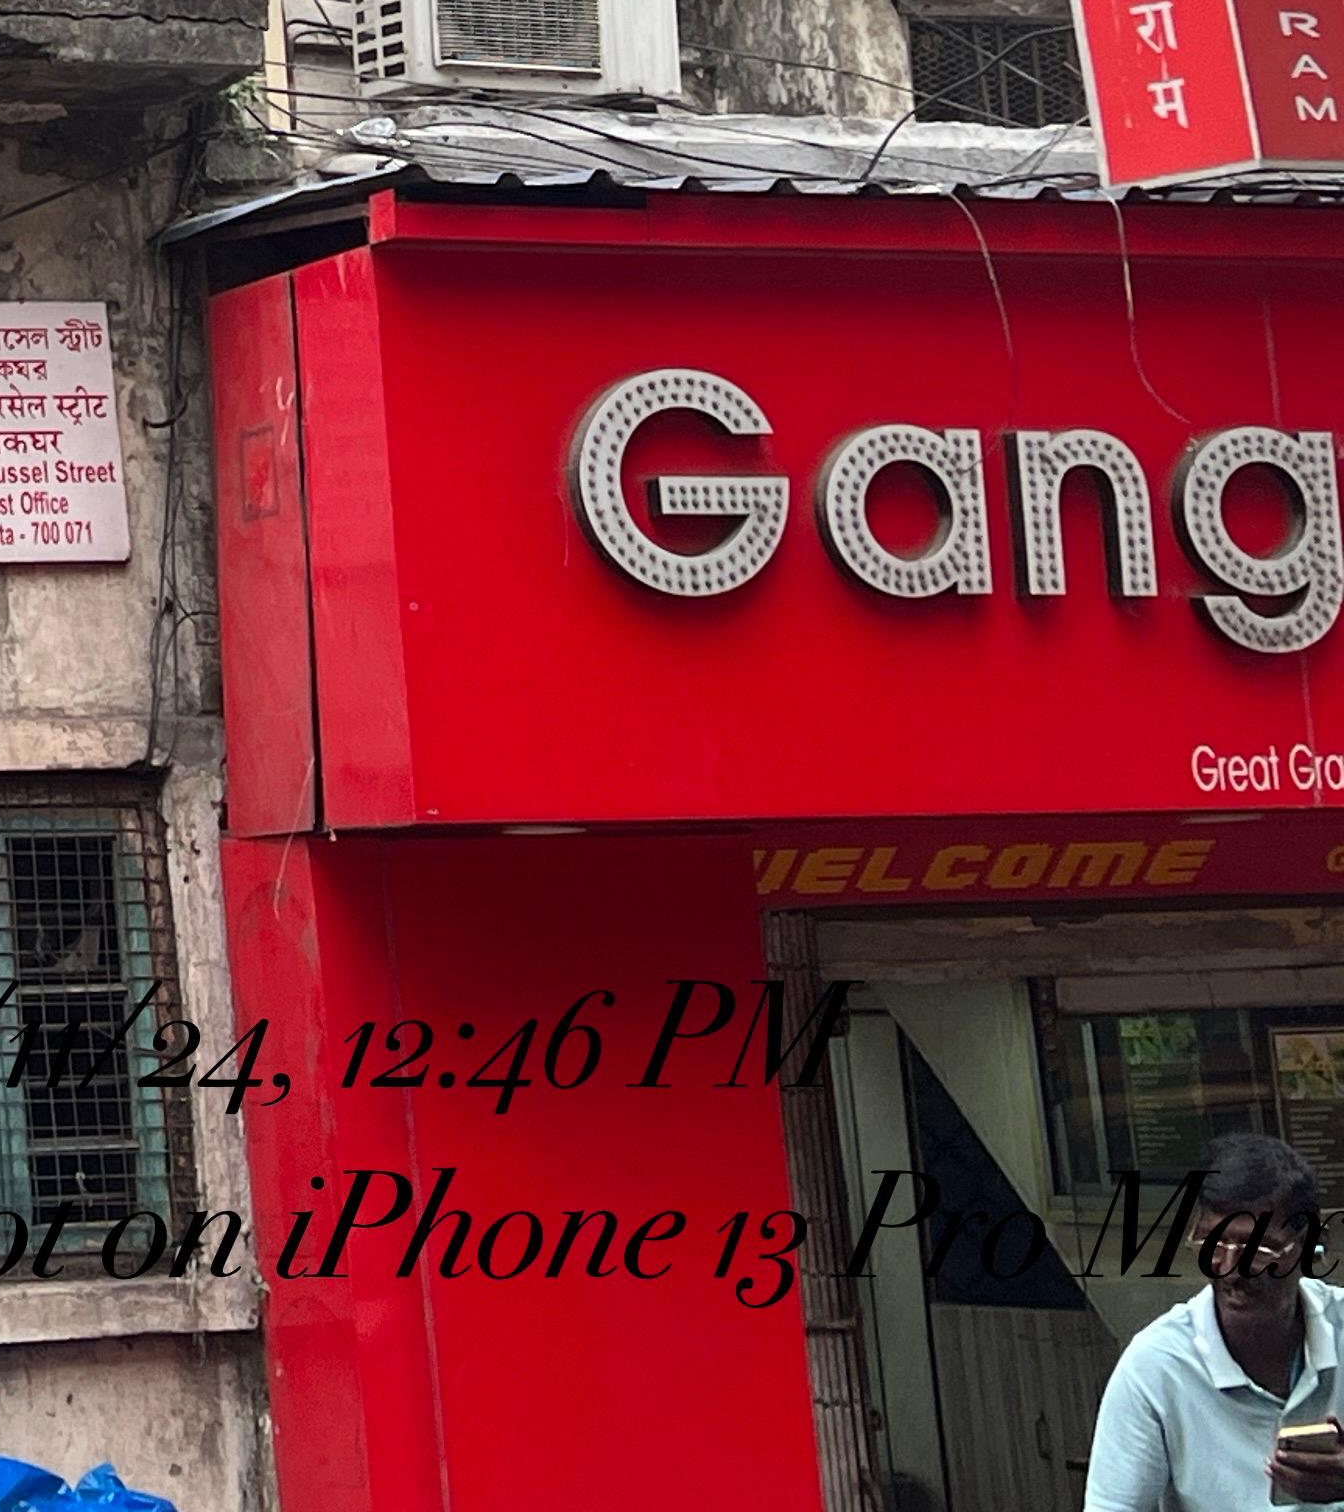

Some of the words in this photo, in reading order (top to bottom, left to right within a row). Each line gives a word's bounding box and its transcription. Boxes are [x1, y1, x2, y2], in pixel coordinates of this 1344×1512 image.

[55, 460, 117, 484] Street
[20, 491, 69, 515] Office
[572, 368, 1344, 654] Gang
[31, 521, 60, 545] 700
[64, 521, 93, 545] 071
[1191, 745, 1280, 791] Great
